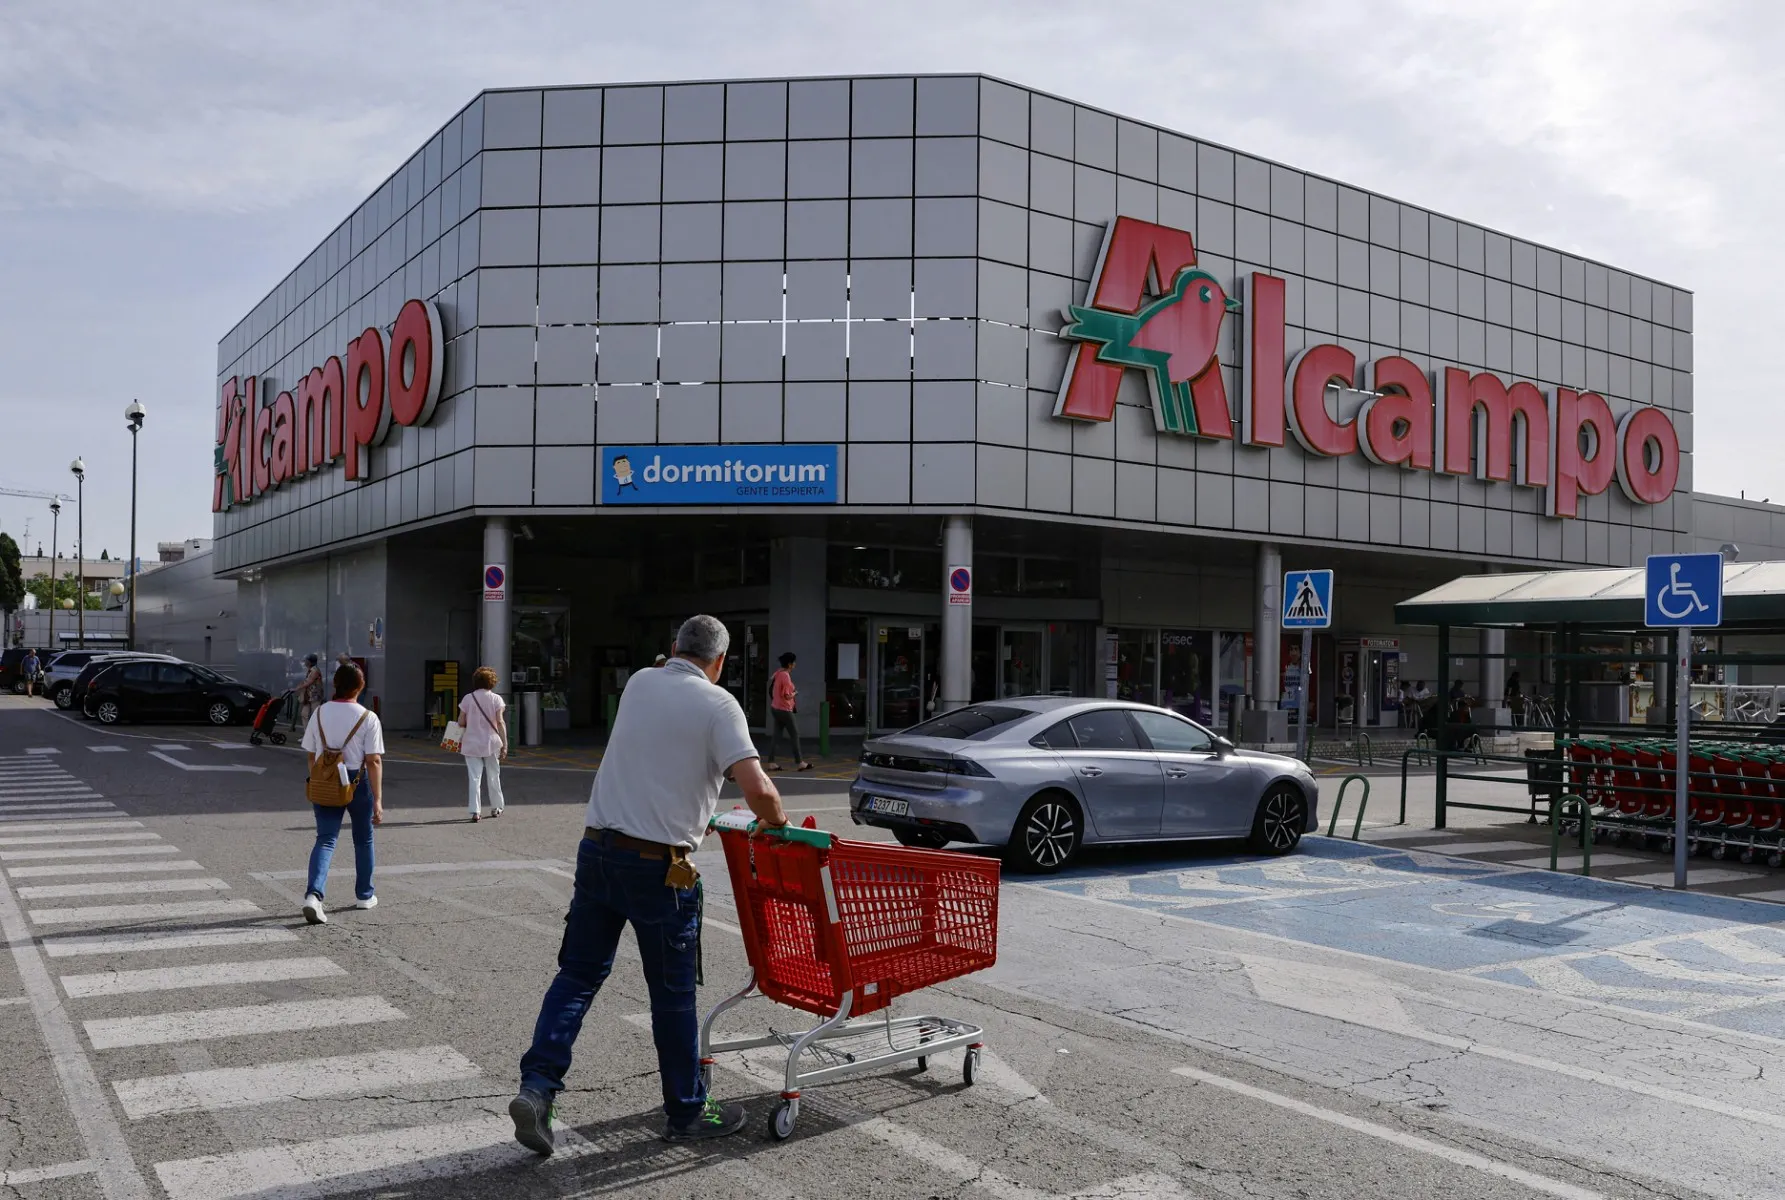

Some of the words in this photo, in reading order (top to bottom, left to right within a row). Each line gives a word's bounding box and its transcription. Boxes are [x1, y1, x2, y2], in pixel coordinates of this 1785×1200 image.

[1053, 215, 1680, 519] Alcampo
[212, 298, 441, 513] Alcampo
[643, 455, 827, 483] dormitorum
[736, 486, 769, 496] GENTE
[771, 486, 825, 496] DESPIERTA
[874, 799, 891, 811] 5237
[891, 802, 906, 814] LXR
